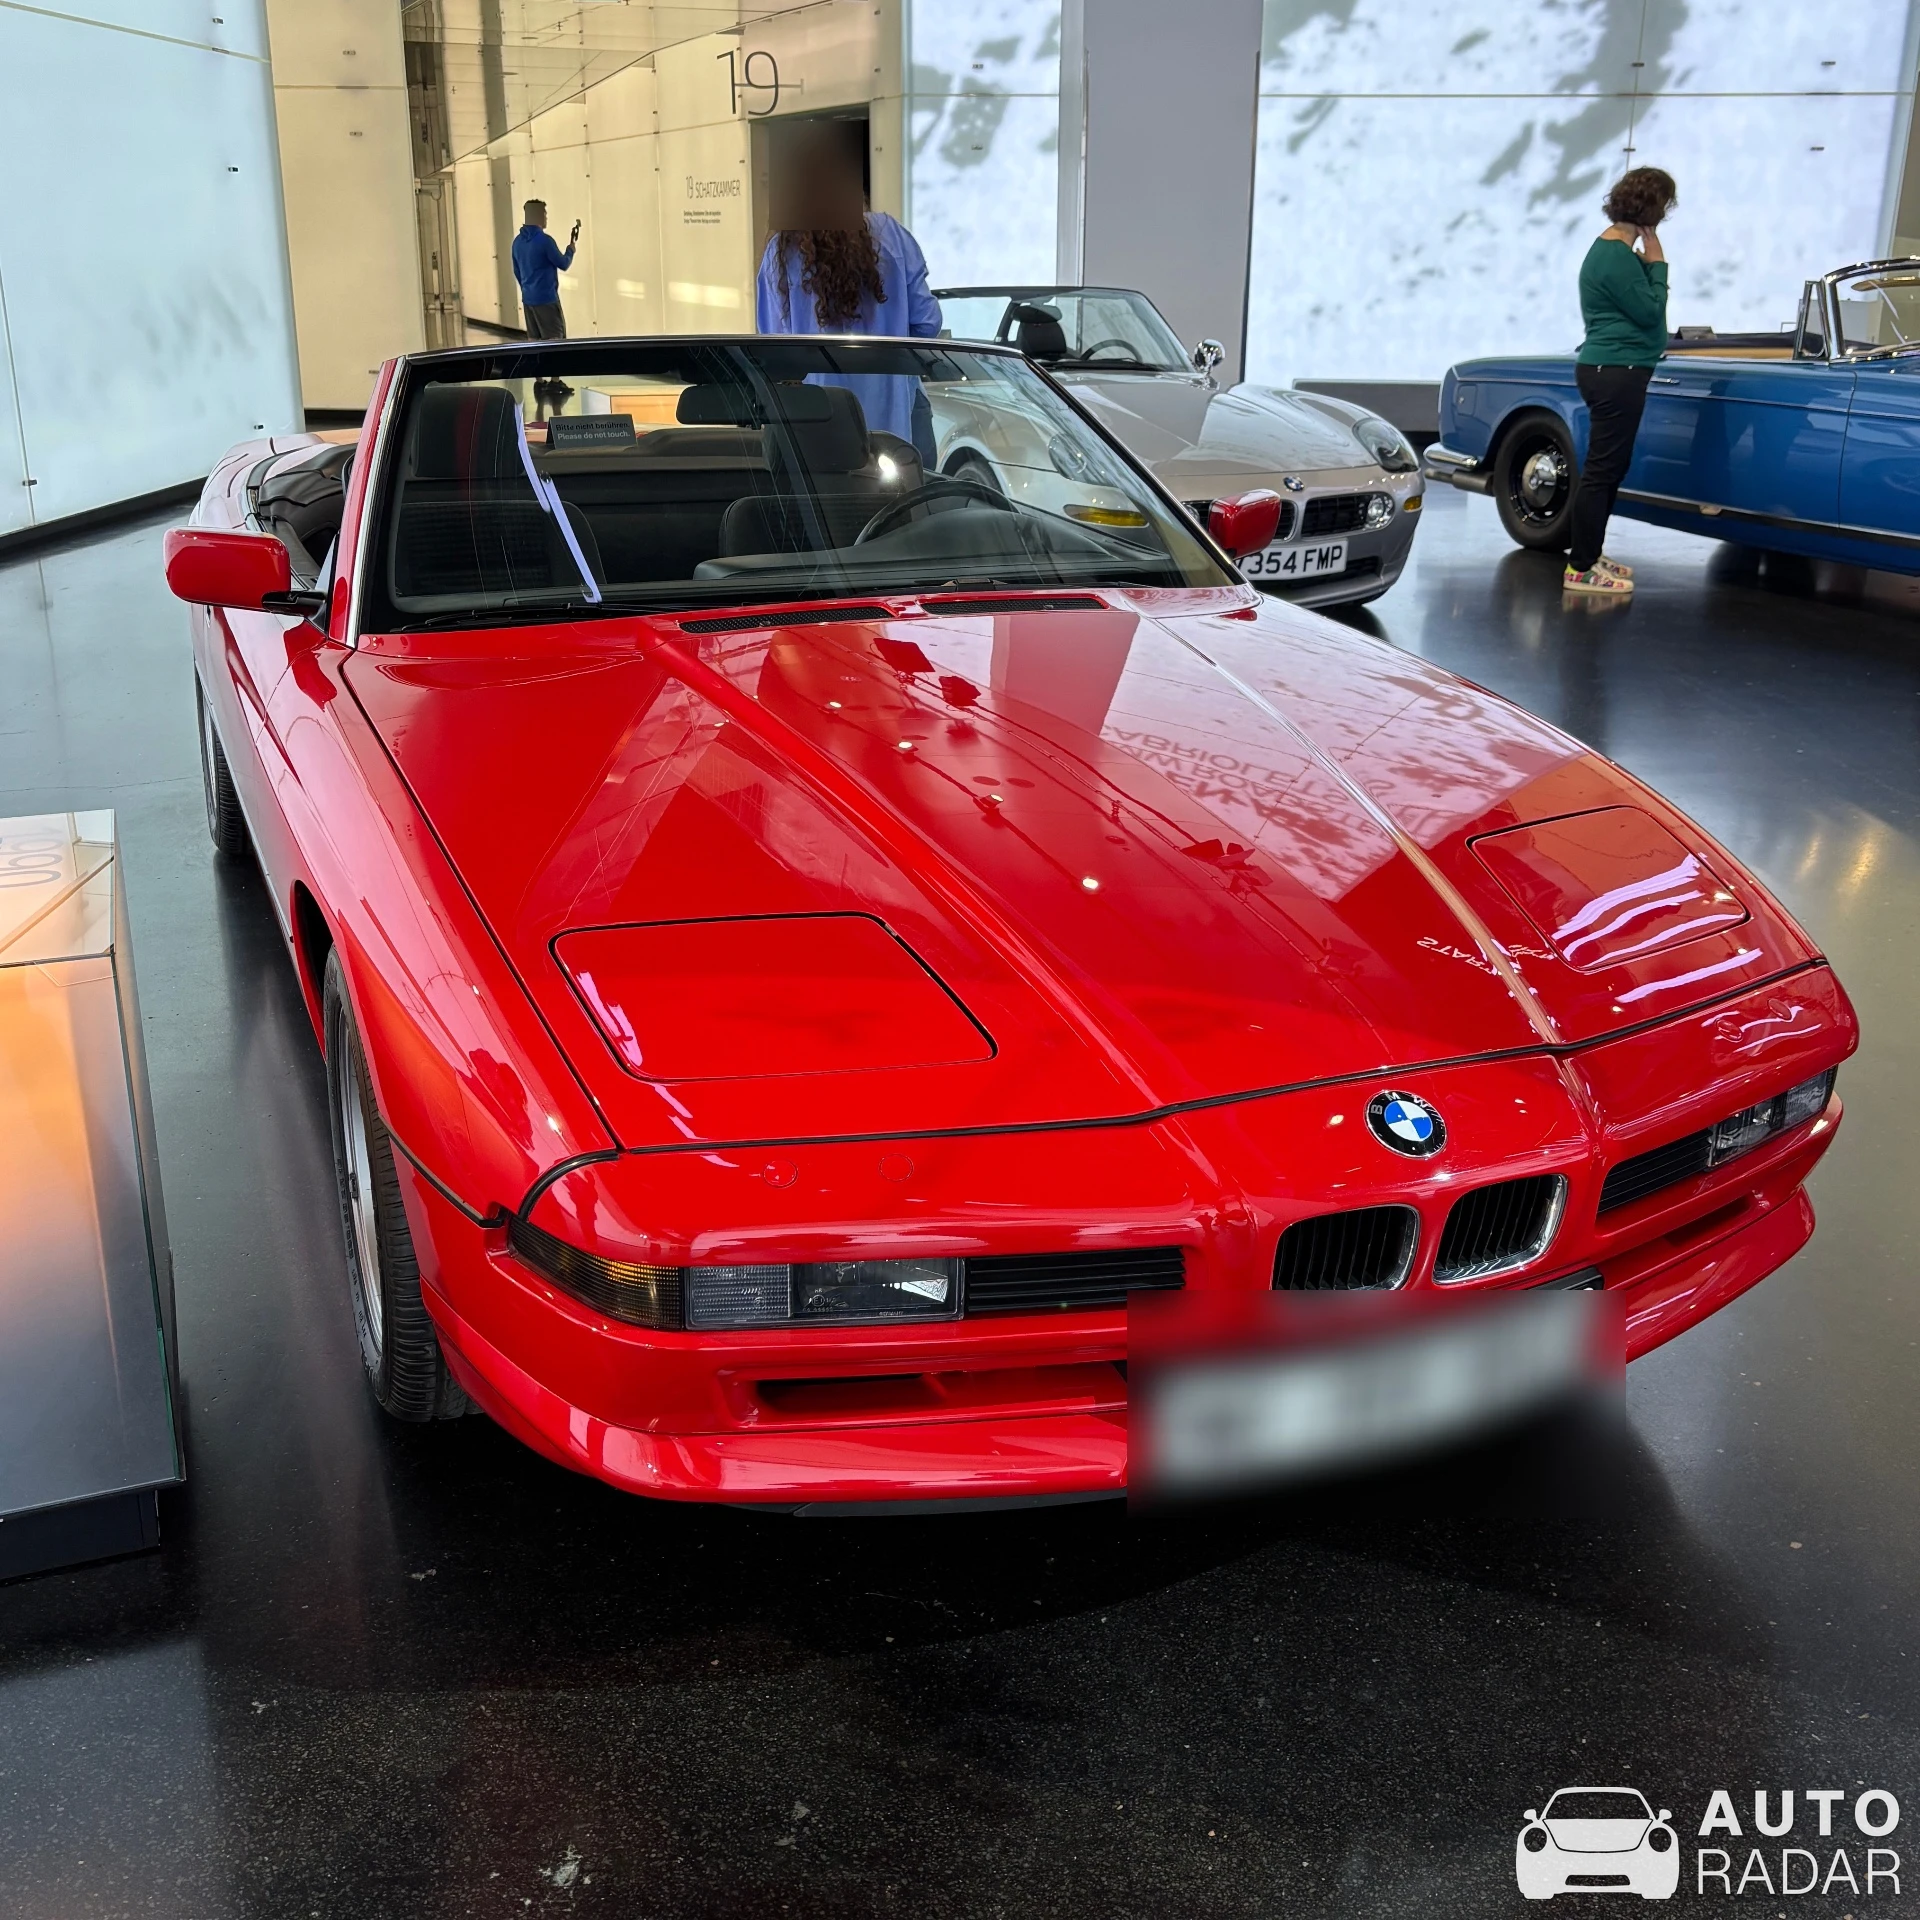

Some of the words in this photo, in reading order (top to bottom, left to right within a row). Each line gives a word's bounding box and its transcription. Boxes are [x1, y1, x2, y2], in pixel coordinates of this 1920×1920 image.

[716, 50, 779, 116] 19
[686, 175, 693, 199] 19
[695, 179, 741, 198] SCHATZKAMMER
[595, 421, 630, 430] berühren.
[607, 430, 630, 438] touch.
[1303, 545, 1343, 573] FMP
